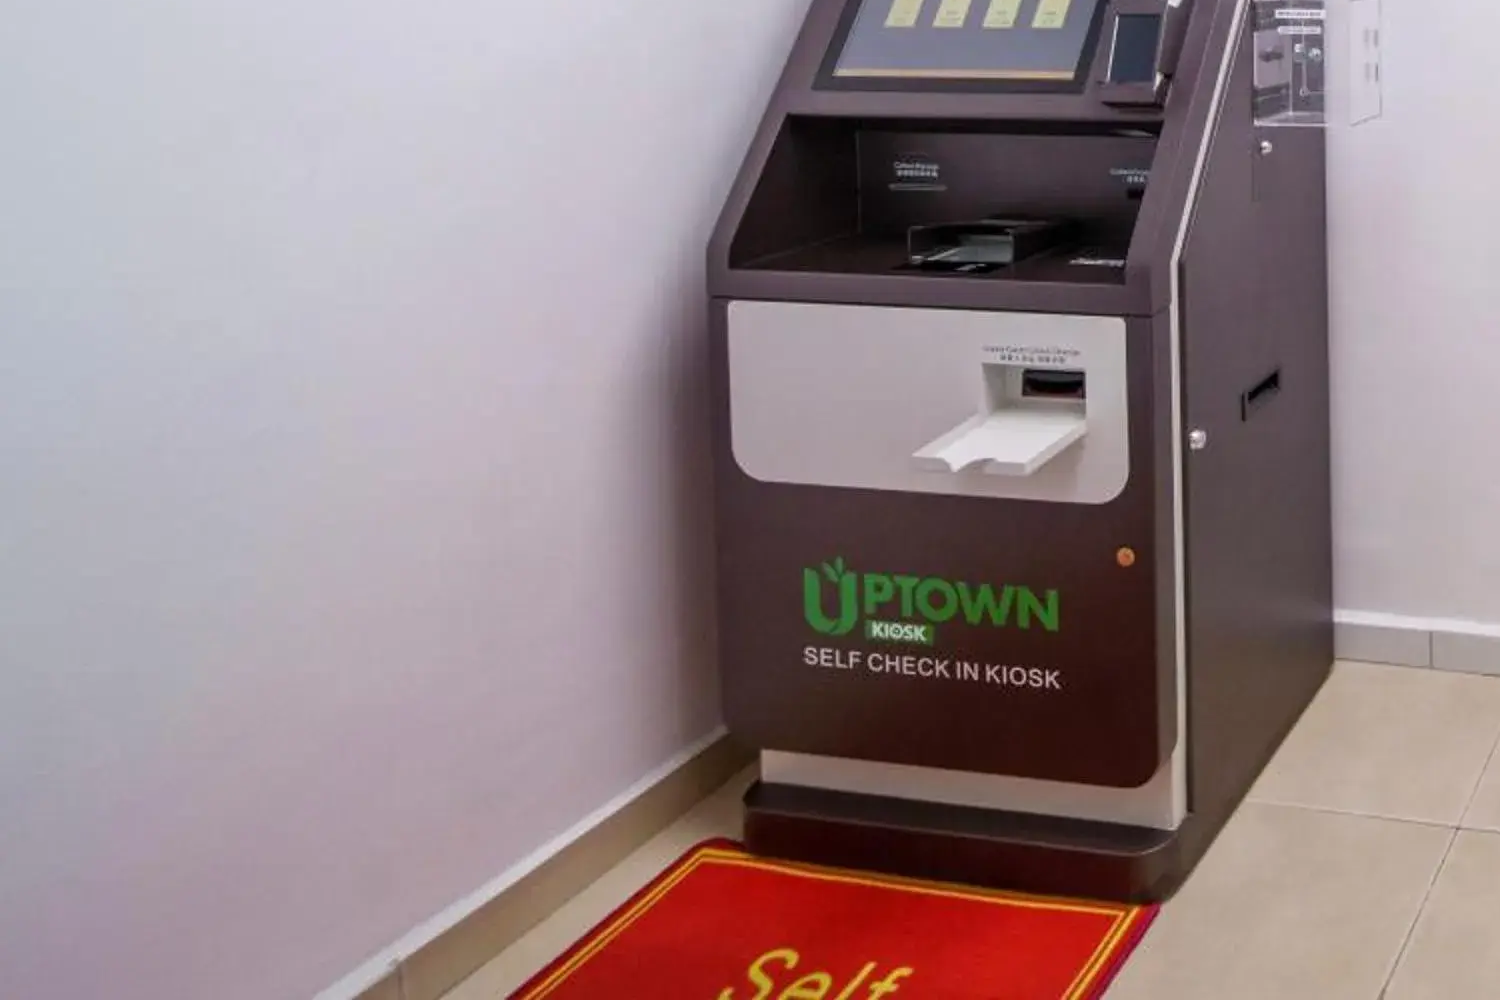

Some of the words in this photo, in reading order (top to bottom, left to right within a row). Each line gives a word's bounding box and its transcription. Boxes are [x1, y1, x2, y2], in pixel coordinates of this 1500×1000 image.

[804, 557, 1060, 636] UPTOWN
[871, 620, 928, 642] KIOSK
[803, 646, 862, 669] SELF
[866, 652, 950, 679] CHECK
[956, 661, 980, 682] IN
[985, 664, 1061, 689] KIOSK
